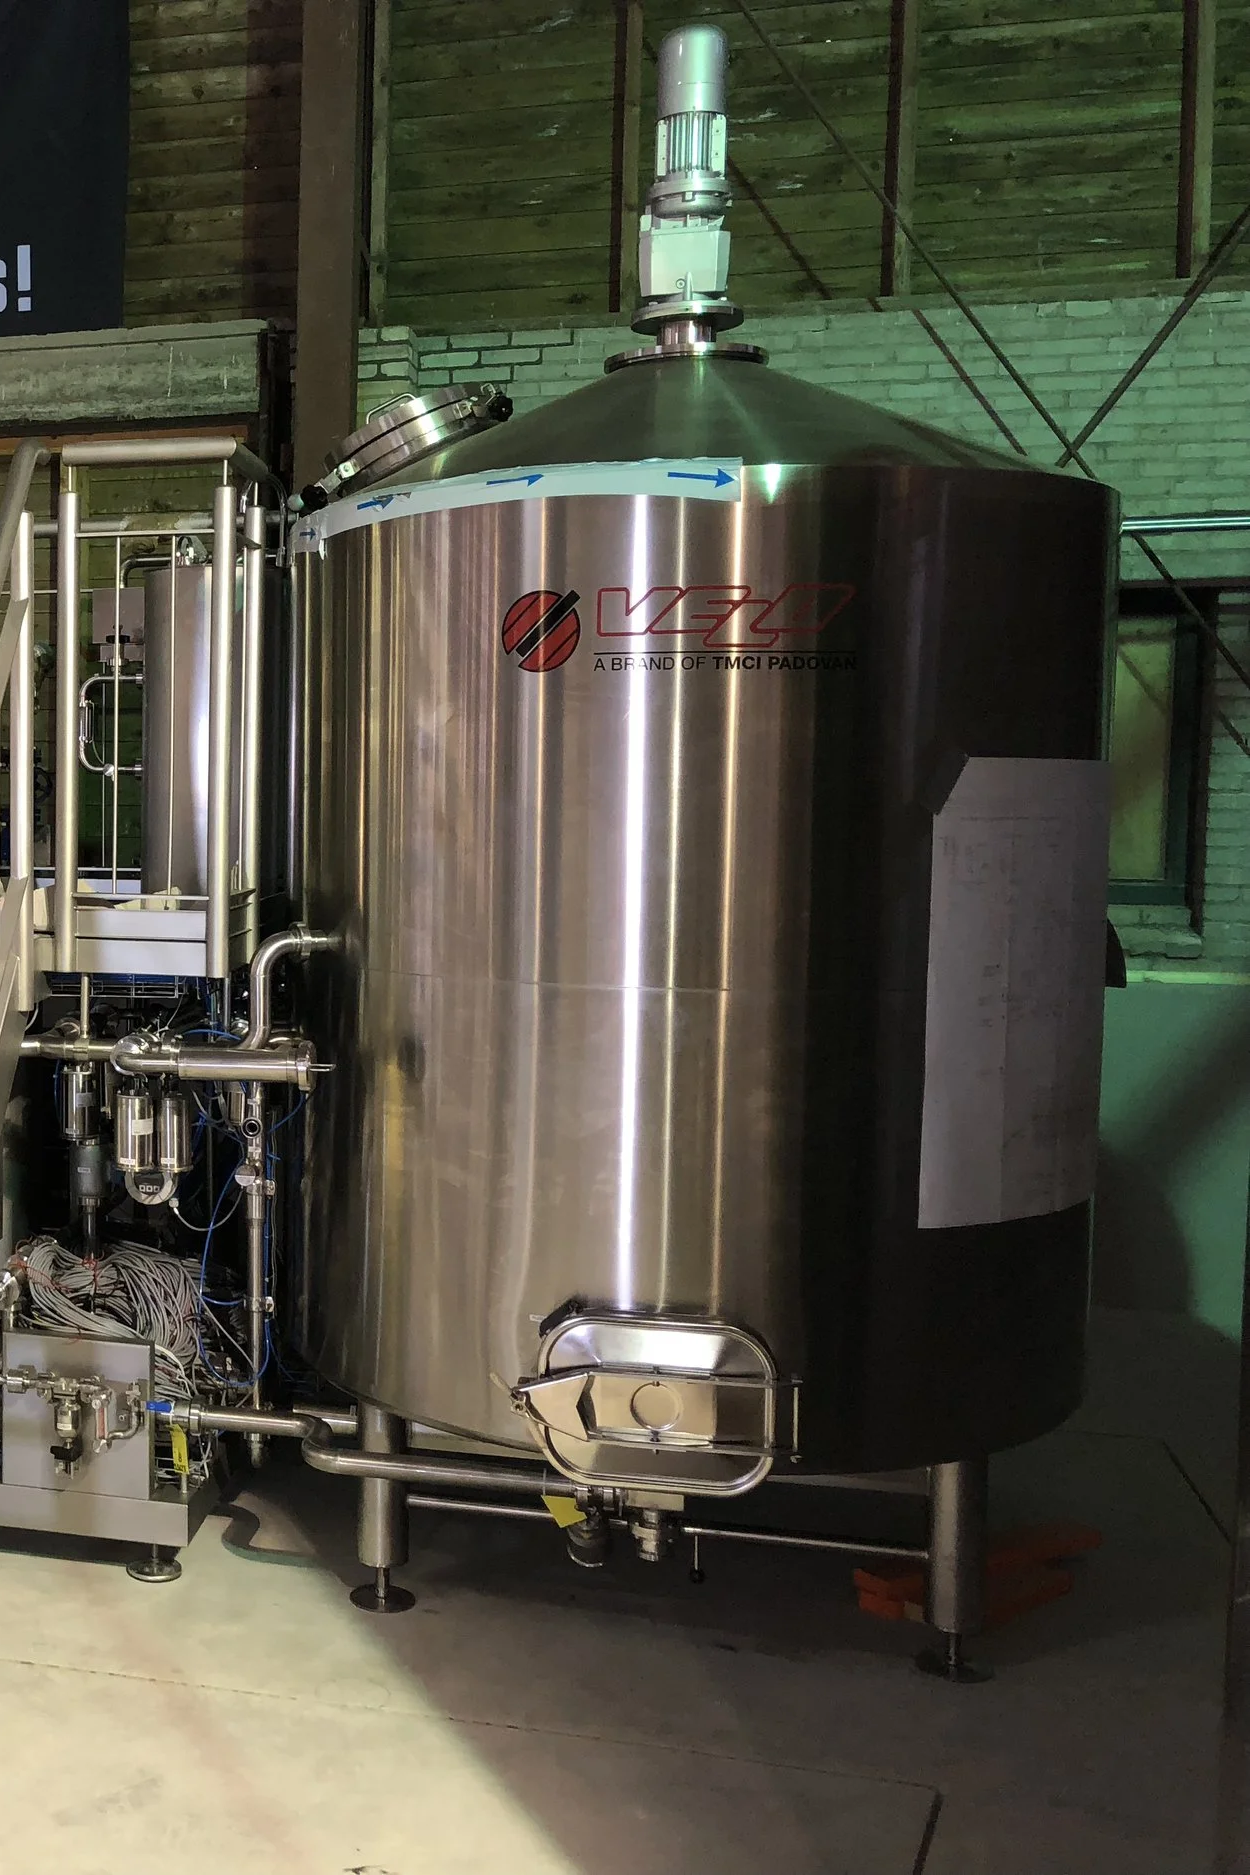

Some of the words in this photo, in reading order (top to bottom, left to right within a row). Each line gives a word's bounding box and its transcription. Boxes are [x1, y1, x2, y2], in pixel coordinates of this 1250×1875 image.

[594, 657, 606, 671] A
[611, 656, 675, 671] BRAND
[681, 656, 706, 670] OF
[712, 656, 761, 670] TMCI
[768, 655, 857, 671] PADOVAN
